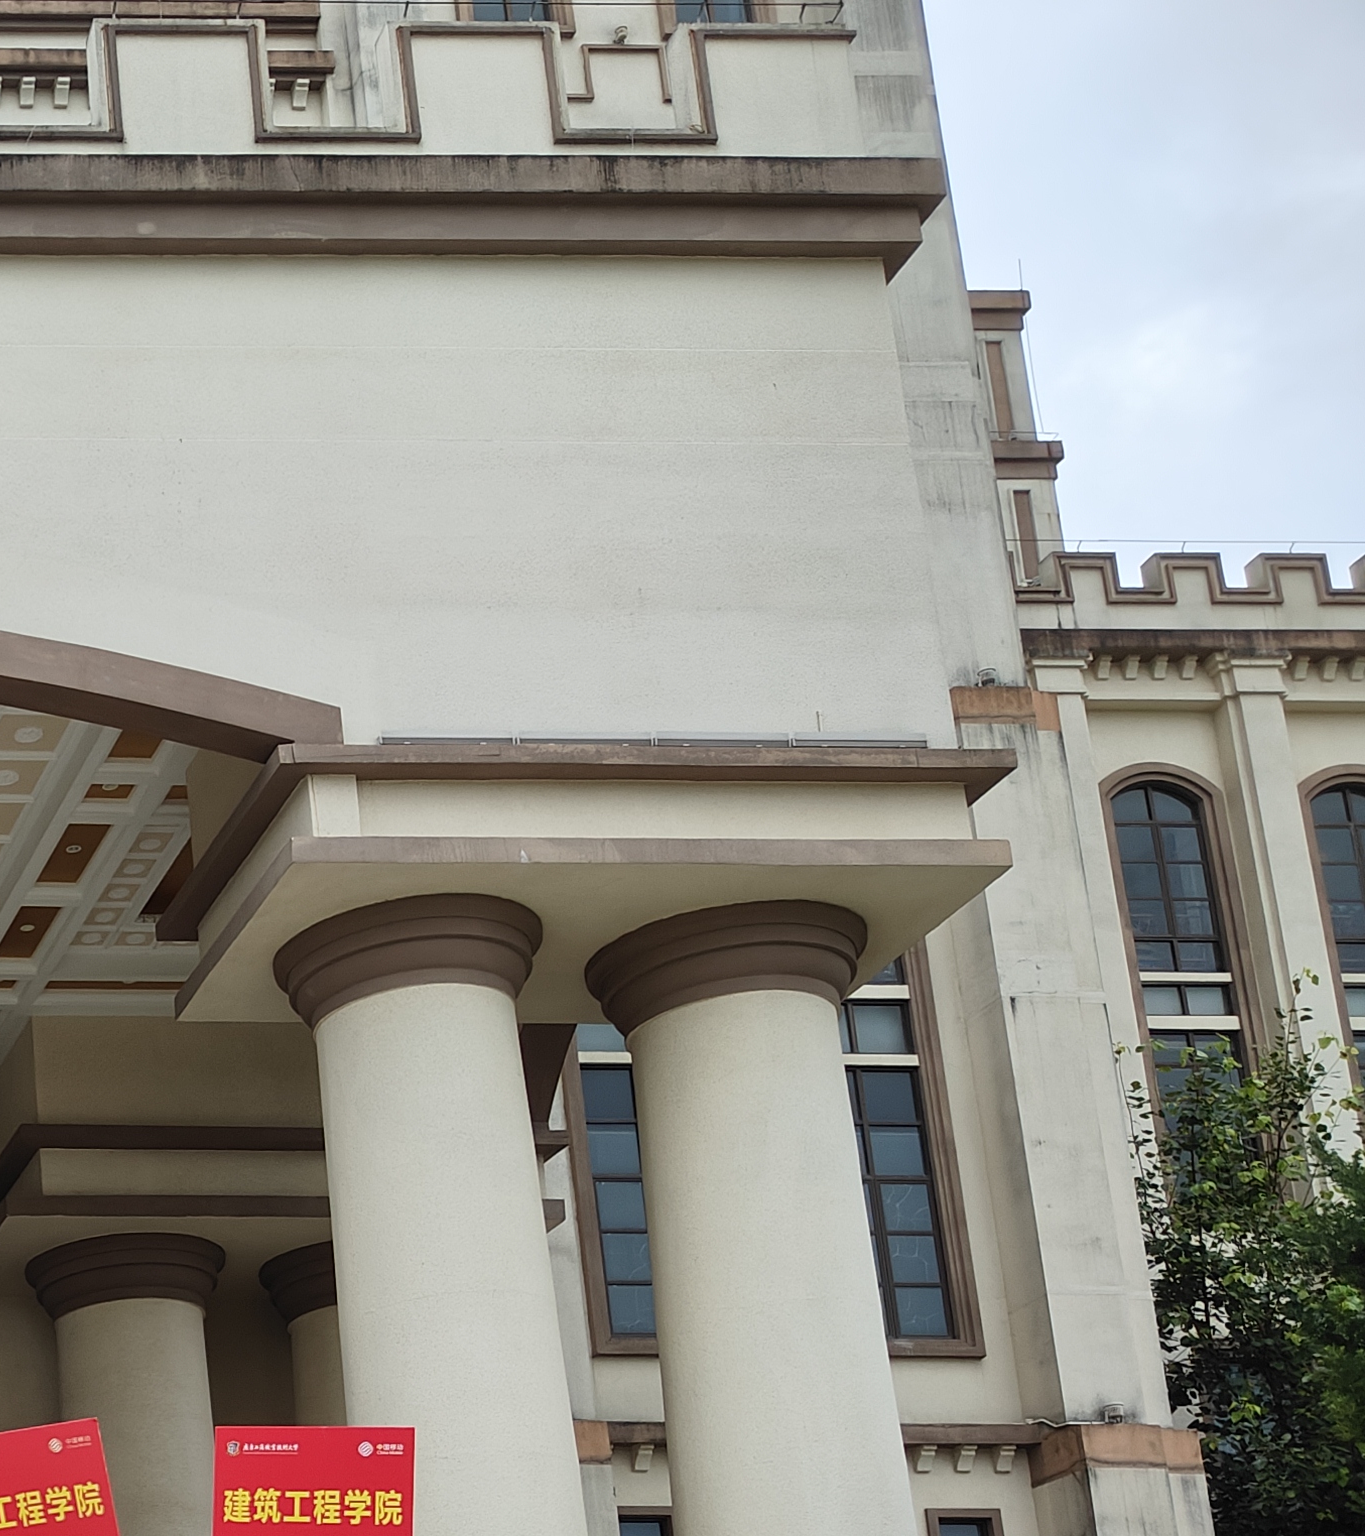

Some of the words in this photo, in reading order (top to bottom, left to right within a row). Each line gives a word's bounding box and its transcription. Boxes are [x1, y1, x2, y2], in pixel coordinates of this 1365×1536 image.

[222, 1487, 404, 1526] 建筑工程学院
